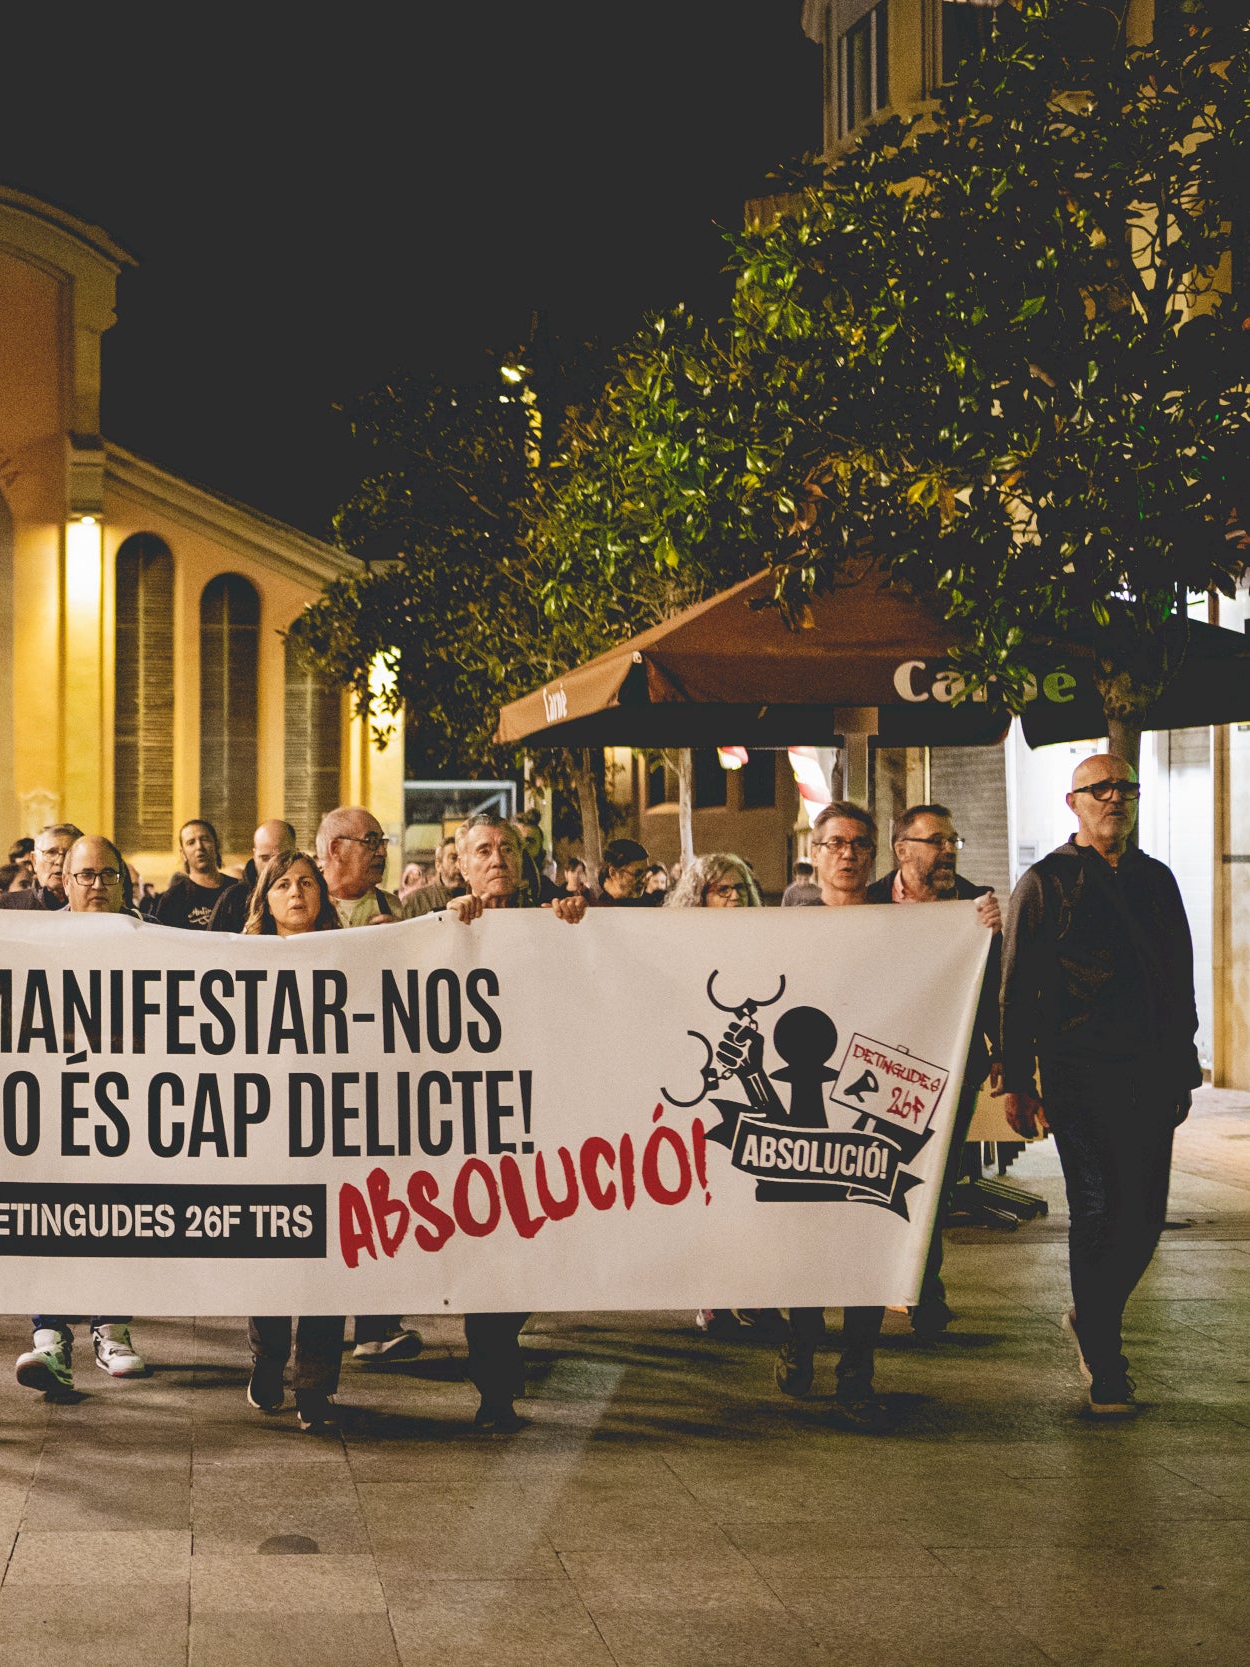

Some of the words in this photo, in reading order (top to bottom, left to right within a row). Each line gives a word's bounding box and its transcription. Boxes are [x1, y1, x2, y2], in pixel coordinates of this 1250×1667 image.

[853, 1044, 941, 1092] DETINGUDES
[60, 1050, 131, 1157] ÉS
[147, 1072, 271, 1157] CAP
[288, 1069, 534, 1157] DELICTE!
[886, 1086, 925, 1124] 26F
[741, 1134, 889, 1179] ABSOLUCIÓ!
[338, 1102, 712, 1269] ABSOLUCIÓ!
[185, 1204, 241, 1237] 26F
[250, 1205, 313, 1238] TRS
